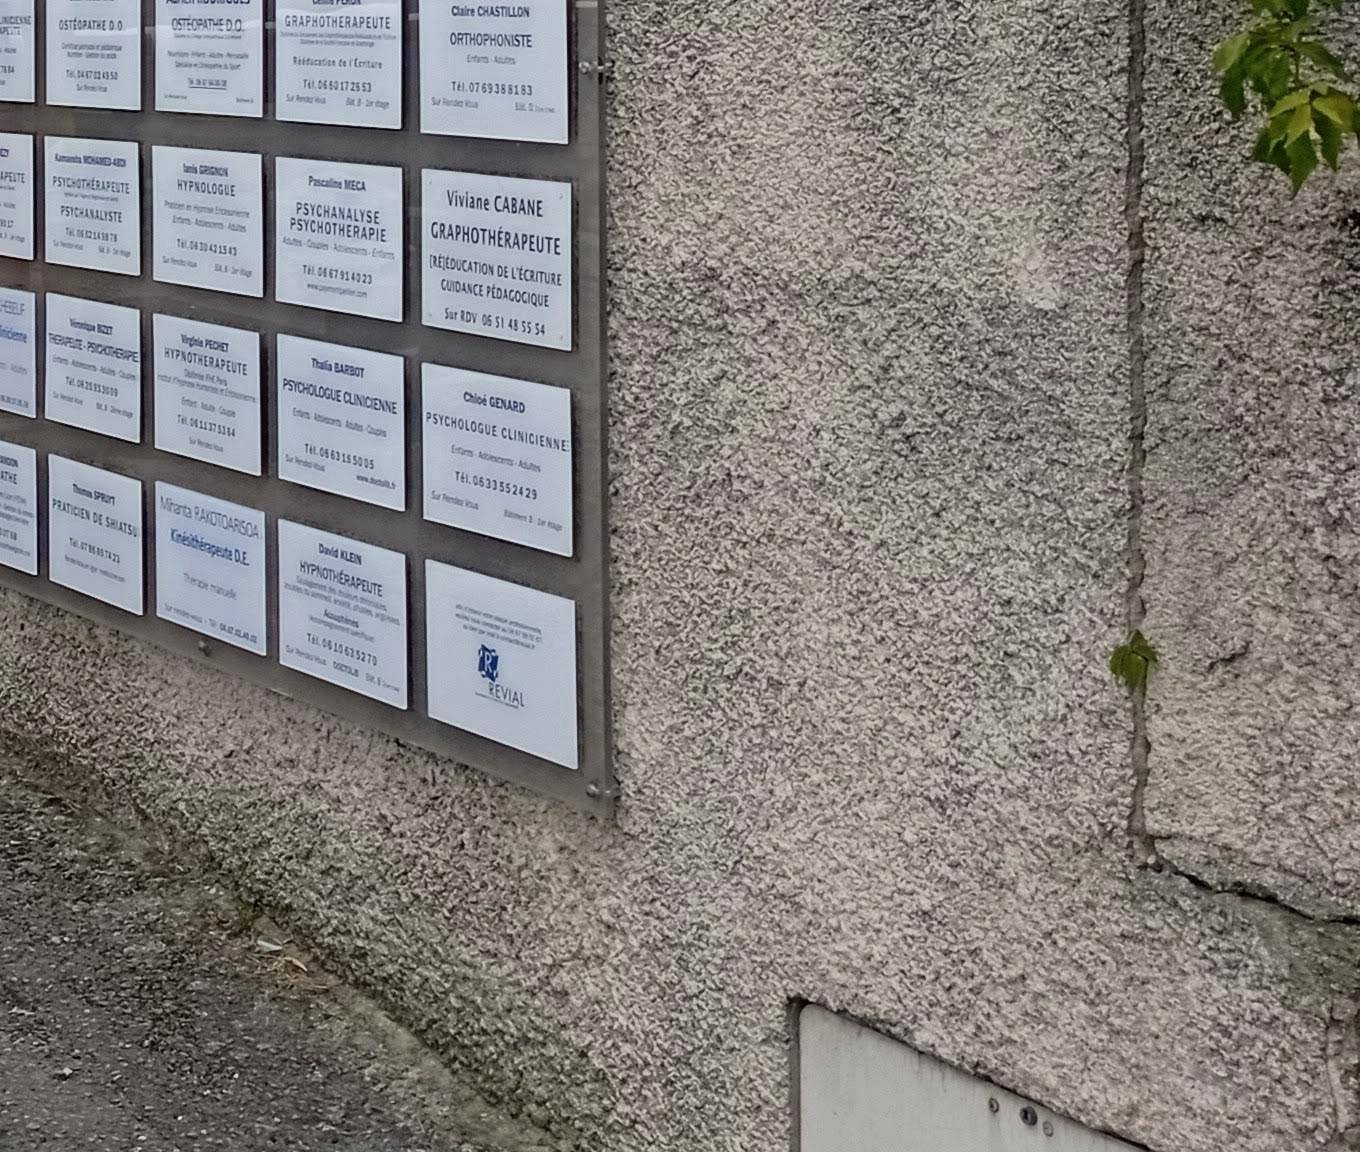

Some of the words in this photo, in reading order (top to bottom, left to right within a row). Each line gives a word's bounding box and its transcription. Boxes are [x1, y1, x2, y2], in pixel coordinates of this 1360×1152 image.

[284, 15, 390, 29] GRAPHOTHERAPEUTE
[451, 5, 475, 16] Claire
[171, 17, 224, 31] OSTÉOPATHE
[449, 32, 532, 48] ORTHOPHONISTE
[177, 179, 235, 197] HYPNOLOGUE
[296, 201, 379, 224] PSYCHANALYSE
[446, 189, 489, 211] Viviane
[494, 195, 543, 217] CABANE
[290, 217, 386, 242] PSYCHOTHERAPIE
[430, 221, 560, 255] GRAPHOTHÉRAPEUTE
[497, 264, 508, 278] DE
[511, 266, 561, 286] L'ÉCRITURE
[441, 278, 483, 297] GUIDANCE
[486, 285, 549, 308] PÉDAGOGIQUE
[444, 307, 457, 321] Sur
[460, 309, 477, 324] RDV
[481, 313, 491, 327] 06
[495, 315, 503, 329] 51
[521, 320, 531, 334] 55
[535, 322, 544, 336] 54
[164, 346, 247, 376] HYPNOTHERAPEUTE
[282, 377, 341, 402] PSYCHOLOGUE
[343, 390, 397, 415] CLINICIENNE
[489, 395, 525, 414] GENARD
[426, 411, 497, 437] PSYCHOLOGUE
[340, 549, 361, 565] KLEIN
[299, 559, 382, 597] HYPNOTHÉRAPEUTE
[488, 679, 524, 709] REVIAL
